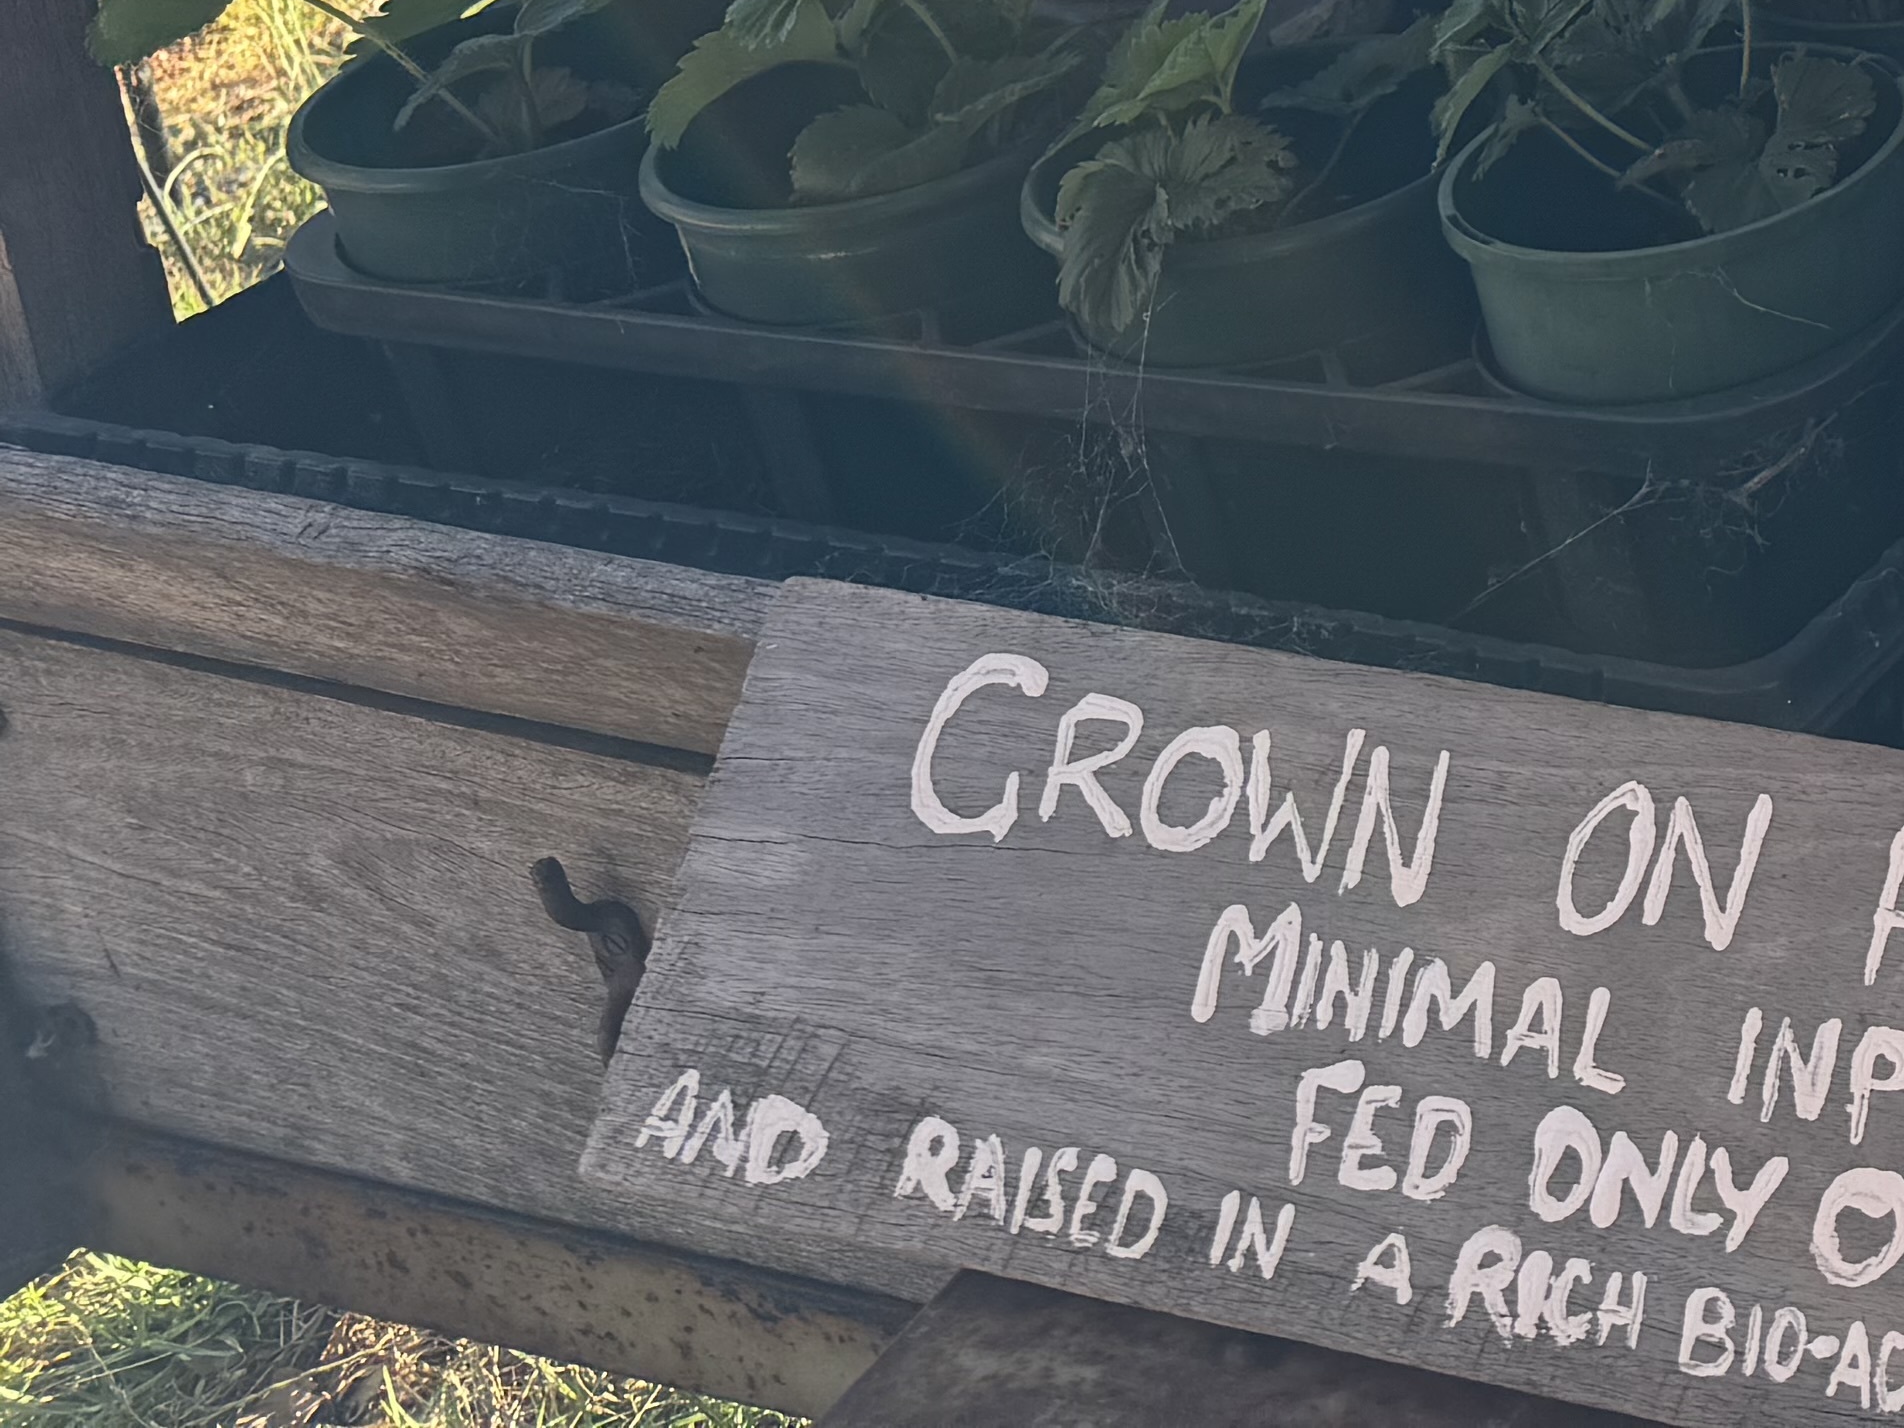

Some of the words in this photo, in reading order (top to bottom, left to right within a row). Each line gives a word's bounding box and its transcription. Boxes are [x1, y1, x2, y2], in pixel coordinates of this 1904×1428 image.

[909, 651, 1450, 906] GROWN
[1556, 779, 1773, 951] ON
[1191, 900, 1626, 1093] MINIMAL
[635, 1067, 830, 1185] AND
[894, 1113, 1170, 1259] RAISED
[1210, 1188, 1296, 1279] IN
[1349, 1226, 1412, 1304] A
[1444, 1223, 1648, 1350] RICH
[1286, 1059, 1472, 1202] FED
[1528, 1104, 1789, 1253] ONLY
